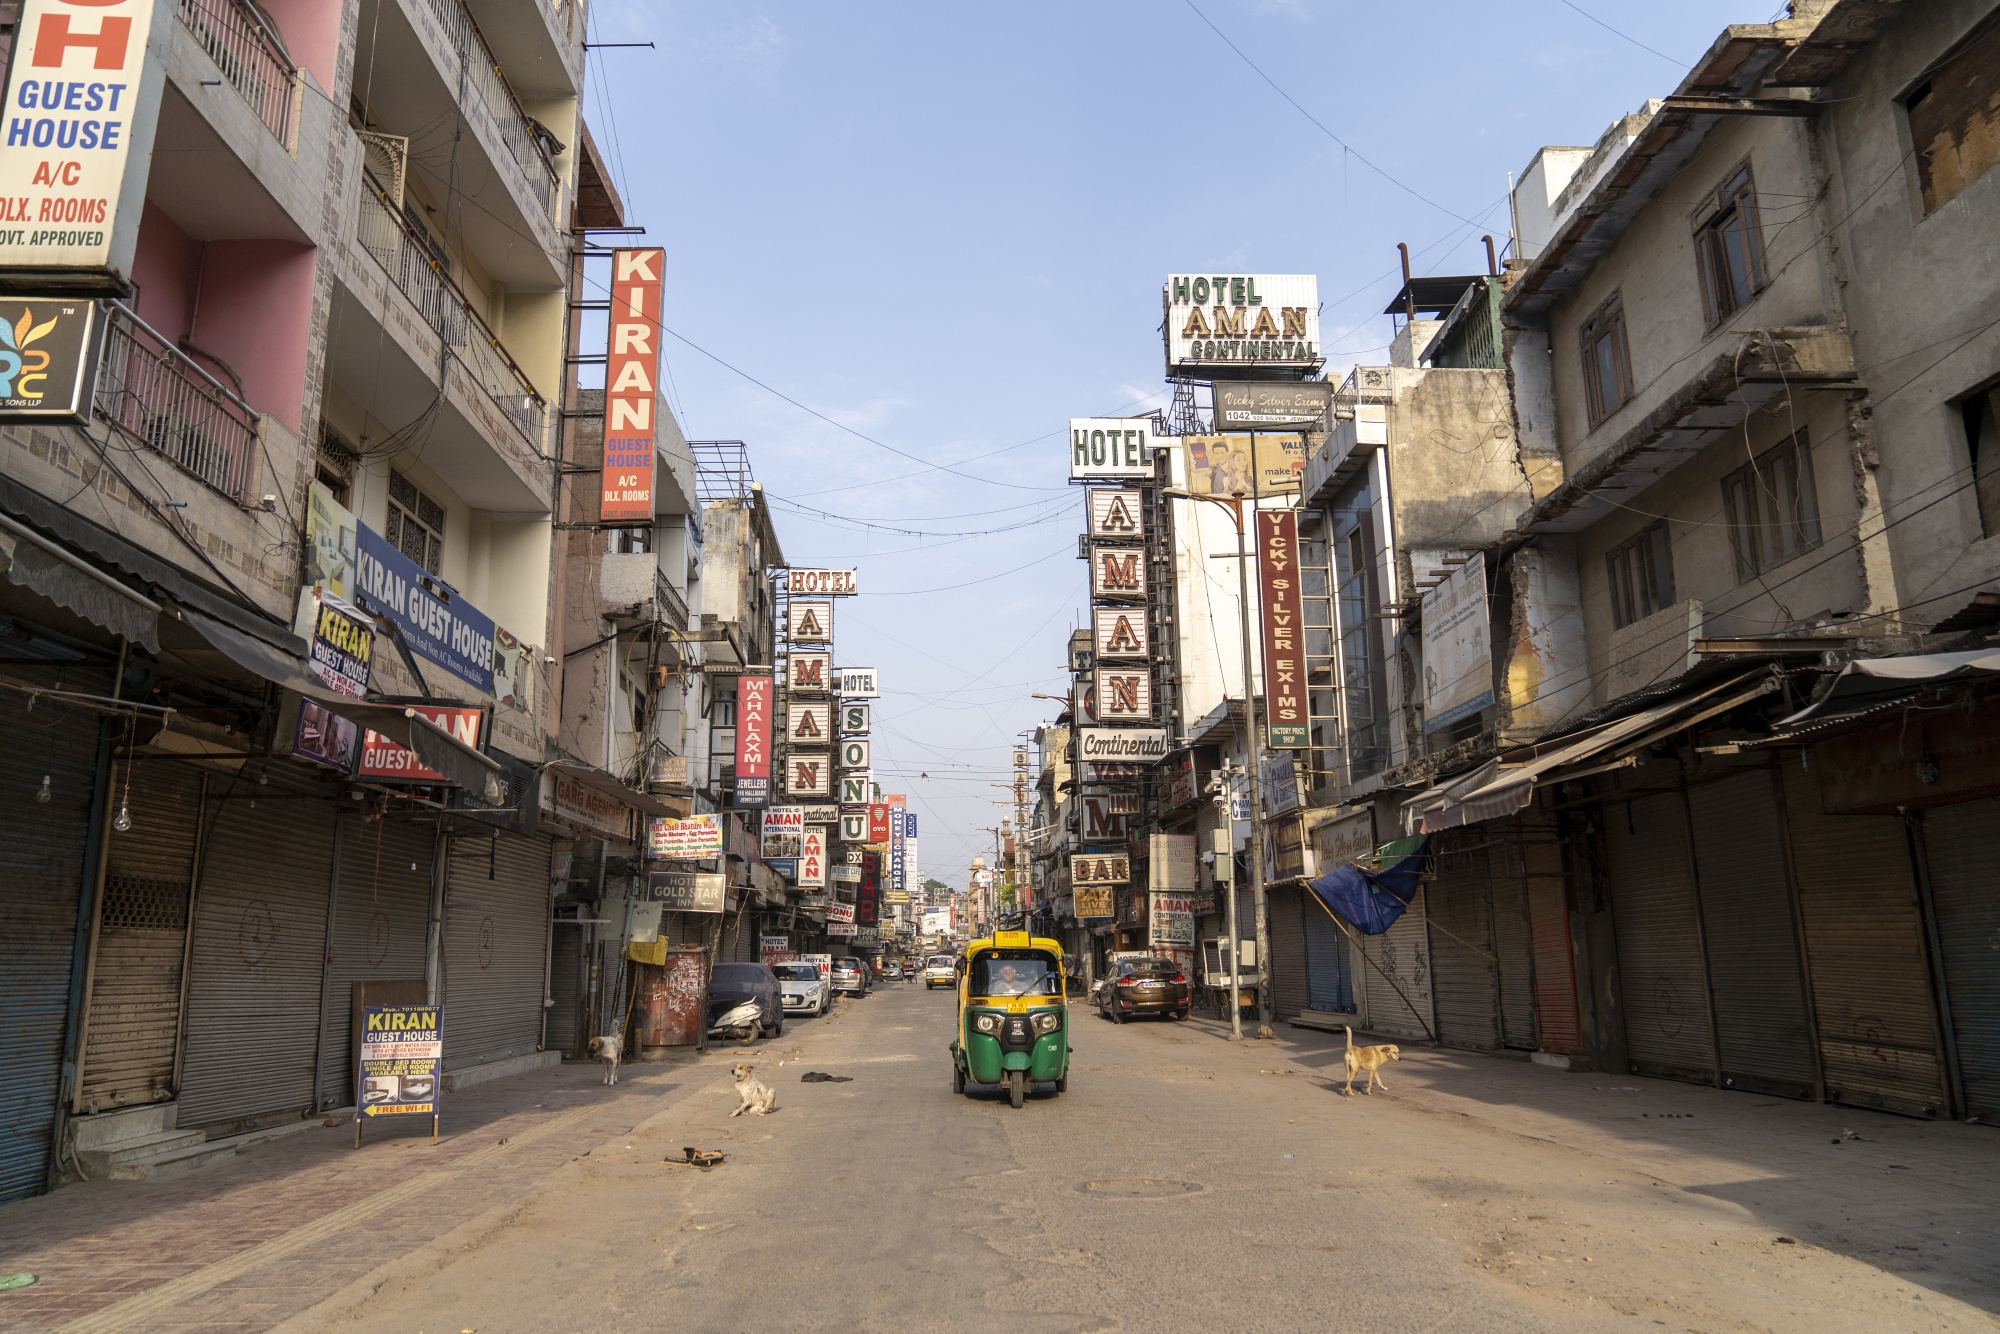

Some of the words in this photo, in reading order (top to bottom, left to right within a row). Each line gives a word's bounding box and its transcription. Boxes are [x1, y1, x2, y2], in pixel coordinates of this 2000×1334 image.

[17, 80, 126, 112] GUEST
[7, 118, 122, 150] HOUSE
[32, 161, 81, 187] A/C
[39, 198, 108, 224] ROOMS
[30, 231, 103, 247] APPROVED
[1173, 277, 1262, 302] HOTEL
[1183, 306, 1307, 336] AMAN
[611, 250, 659, 431] KIRAN
[1191, 341, 1317, 358] CONTINENTAL
[1225, 392, 1256, 408] Vicky
[1259, 393, 1291, 406] Silver
[1227, 412, 1250, 421] 1042
[608, 438, 651, 451] GUEST
[1074, 430, 1152, 467] HOTEL
[606, 453, 651, 468] HOUSE
[1265, 467, 1290, 475] make
[618, 475, 637, 487] A/C
[604, 490, 620, 502] DLX.
[622, 489, 649, 502] ROOMS
[1267, 513, 1288, 571] VICKY
[790, 571, 855, 592] HOTEL
[356, 547, 406, 616] KIRAN
[408, 587, 451, 645] GUEST
[451, 616, 492, 672] HOUSE
[1102, 495, 1141, 711] AMAN
[1272, 579, 1293, 650] SILVER
[319, 606, 371, 663] KIRAN
[315, 642, 342, 670] GUEST
[343, 657, 368, 685] HOUSE
[843, 674, 875, 692] HOTEL
[1277, 659, 1297, 719] EXIMS
[794, 608, 823, 788] AMAN
[744, 680, 764, 773] MAHALAXMI
[1272, 726, 1293, 735] FACTORY
[1293, 727, 1305, 736] PRICE
[1084, 734, 1166, 757] Continental
[1283, 735, 1295, 744] SHOP
[364, 748, 414, 770] GUEST
[737, 779, 767, 789] JEWELLERS
[557, 780, 584, 807] GARG
[585, 794, 626, 822] AGENCIES
[1110, 794, 1139, 812] INN
[680, 822, 702, 831] Bhature
[764, 813, 801, 825] AMAN
[804, 835, 821, 878] AMAN
[848, 853, 861, 862] DX
[1075, 859, 1127, 881] BAR
[670, 877, 705, 886] HOTEL
[654, 886, 686, 898] GOLD
[689, 887, 718, 899] STAR
[827, 906, 852, 918] SONU
[1078, 908, 1111, 916] MUSIC
[1153, 899, 1193, 912] AMAN
[368, 1012, 436, 1031] KIRAN
[366, 1031, 401, 1042] GUEST
[403, 1031, 437, 1041] HOUSE
[376, 1105, 402, 1114] FREE
[405, 1104, 430, 1112] WI-FI
